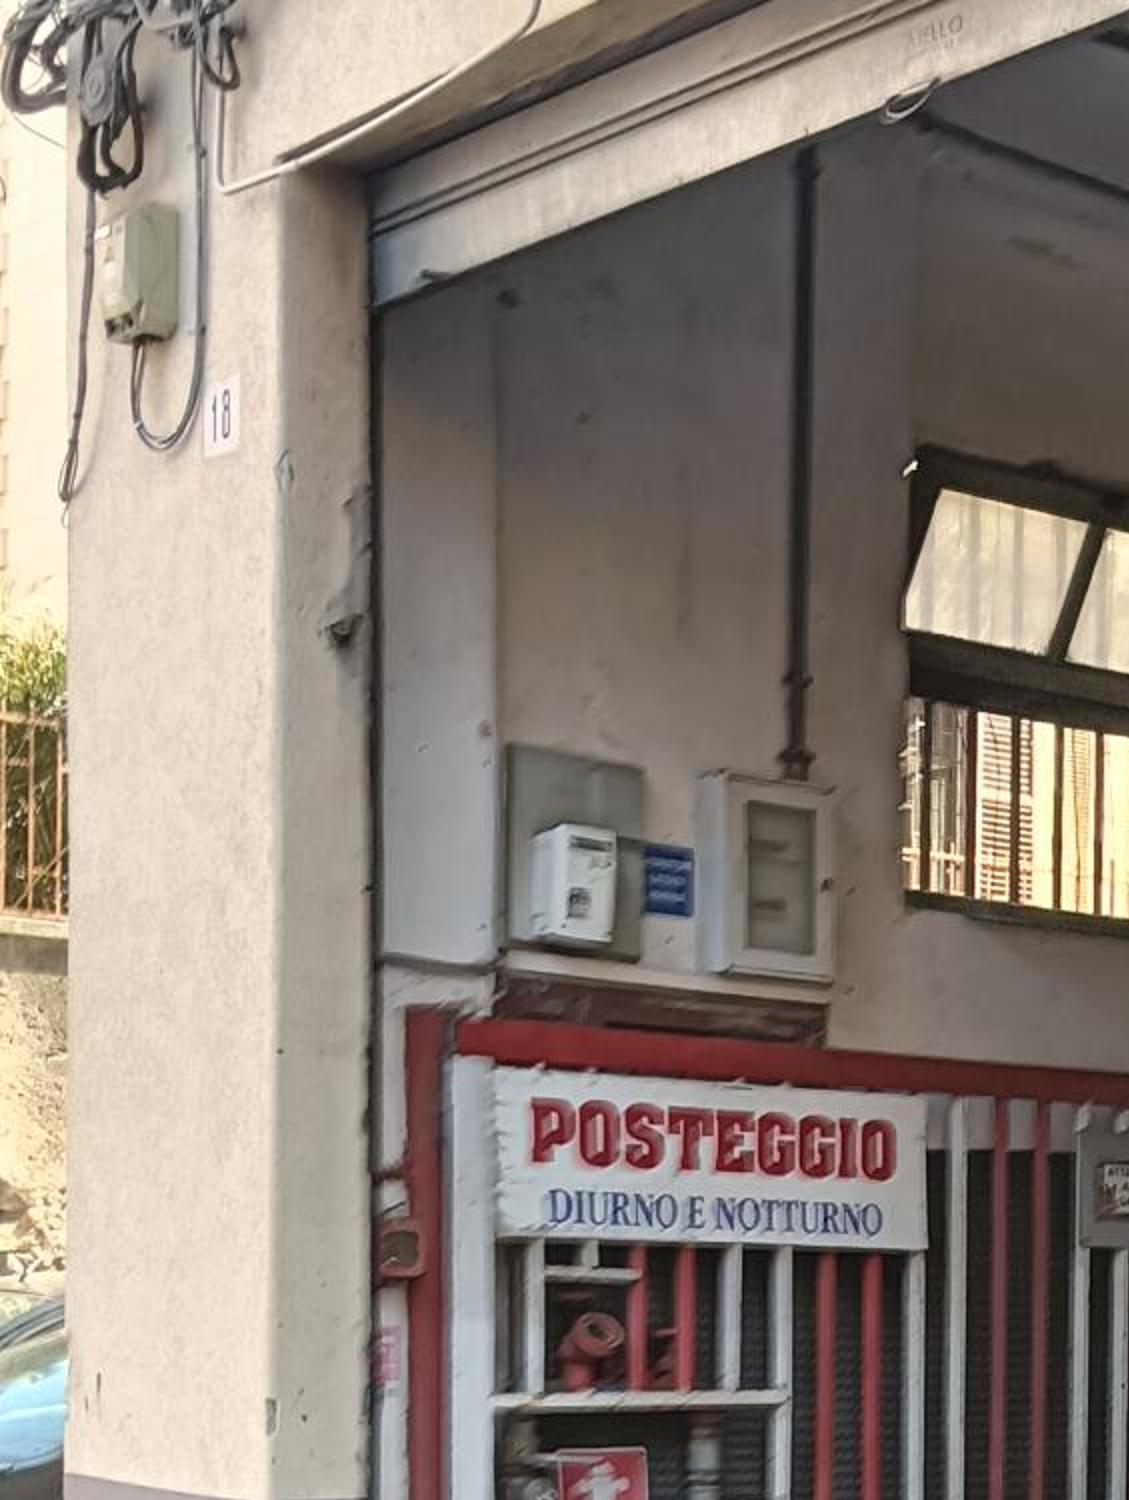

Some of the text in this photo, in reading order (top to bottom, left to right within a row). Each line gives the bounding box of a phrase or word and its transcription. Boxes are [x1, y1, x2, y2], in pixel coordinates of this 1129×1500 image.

[212, 388, 231, 443] 18
[529, 1096, 898, 1181] POSTEGGIO
[547, 1188, 884, 1236] DIURNO E NOTTURNO
